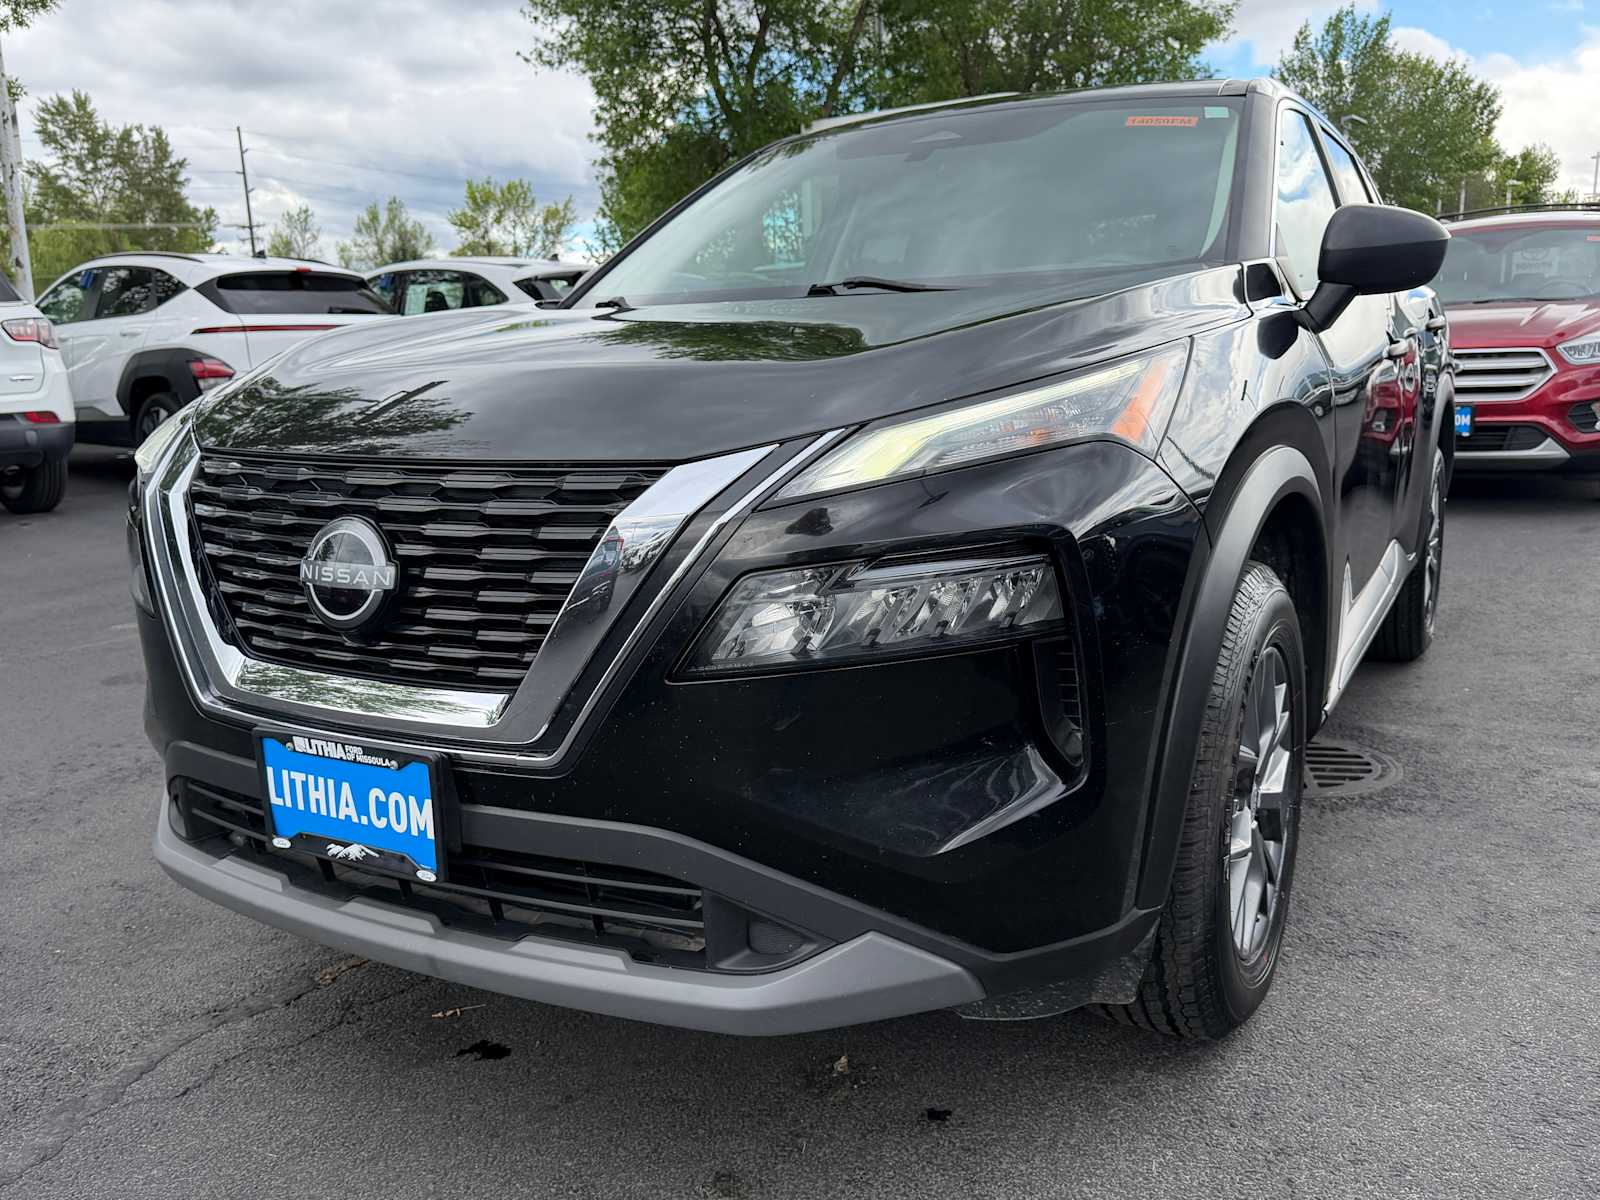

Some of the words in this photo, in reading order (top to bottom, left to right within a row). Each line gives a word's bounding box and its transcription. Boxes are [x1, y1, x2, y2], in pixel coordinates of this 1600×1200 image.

[302, 563, 390, 585] NISSAN
[303, 737, 347, 760] LITHIA
[345, 745, 363, 754] FORD
[346, 753, 356, 761] OF
[356, 754, 391, 767] MISSOULA
[266, 766, 435, 840] LITHIA.COM
